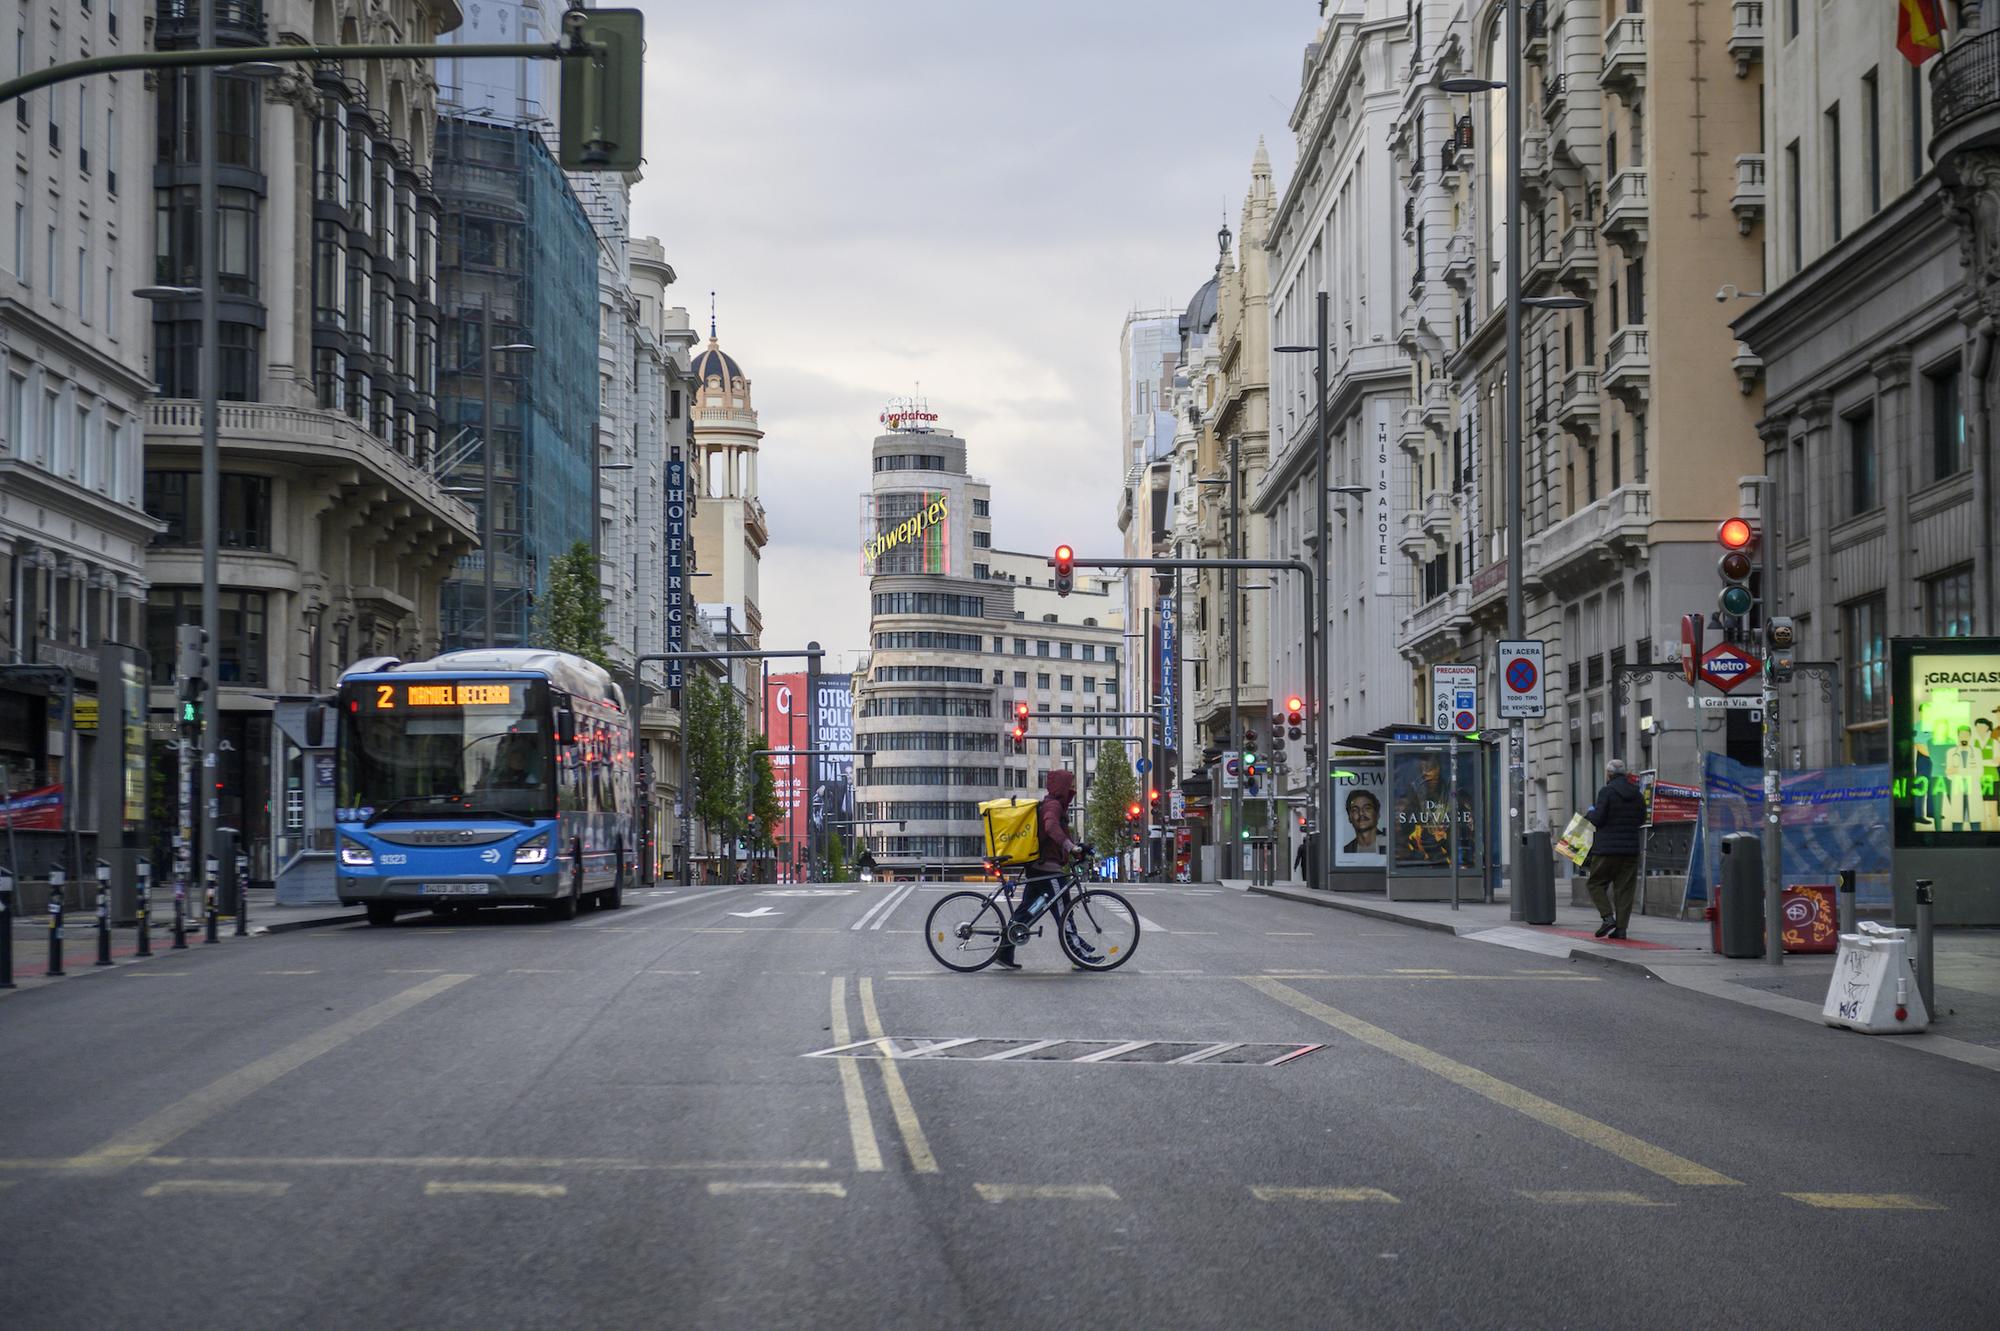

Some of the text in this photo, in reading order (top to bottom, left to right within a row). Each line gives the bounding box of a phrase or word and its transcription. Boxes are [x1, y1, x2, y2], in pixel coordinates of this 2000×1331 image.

[888, 410, 938, 422] vodafone
[1379, 423, 1387, 463] THIS
[1379, 470, 1387, 490] IS
[1379, 497, 1387, 506] A
[863, 496, 949, 566] Schweppes
[1379, 513, 1387, 565] HOTEL
[668, 489, 684, 688] HOTEL REGENTE
[1163, 600, 1171, 649] HOTEL
[1436, 666, 1475, 674] PRECAUCIÓN
[1710, 661, 1744, 671] Metro
[377, 685, 394, 708] 2
[819, 727, 852, 741] QUE ES
[1659, 788, 1691, 797] CIERRE
